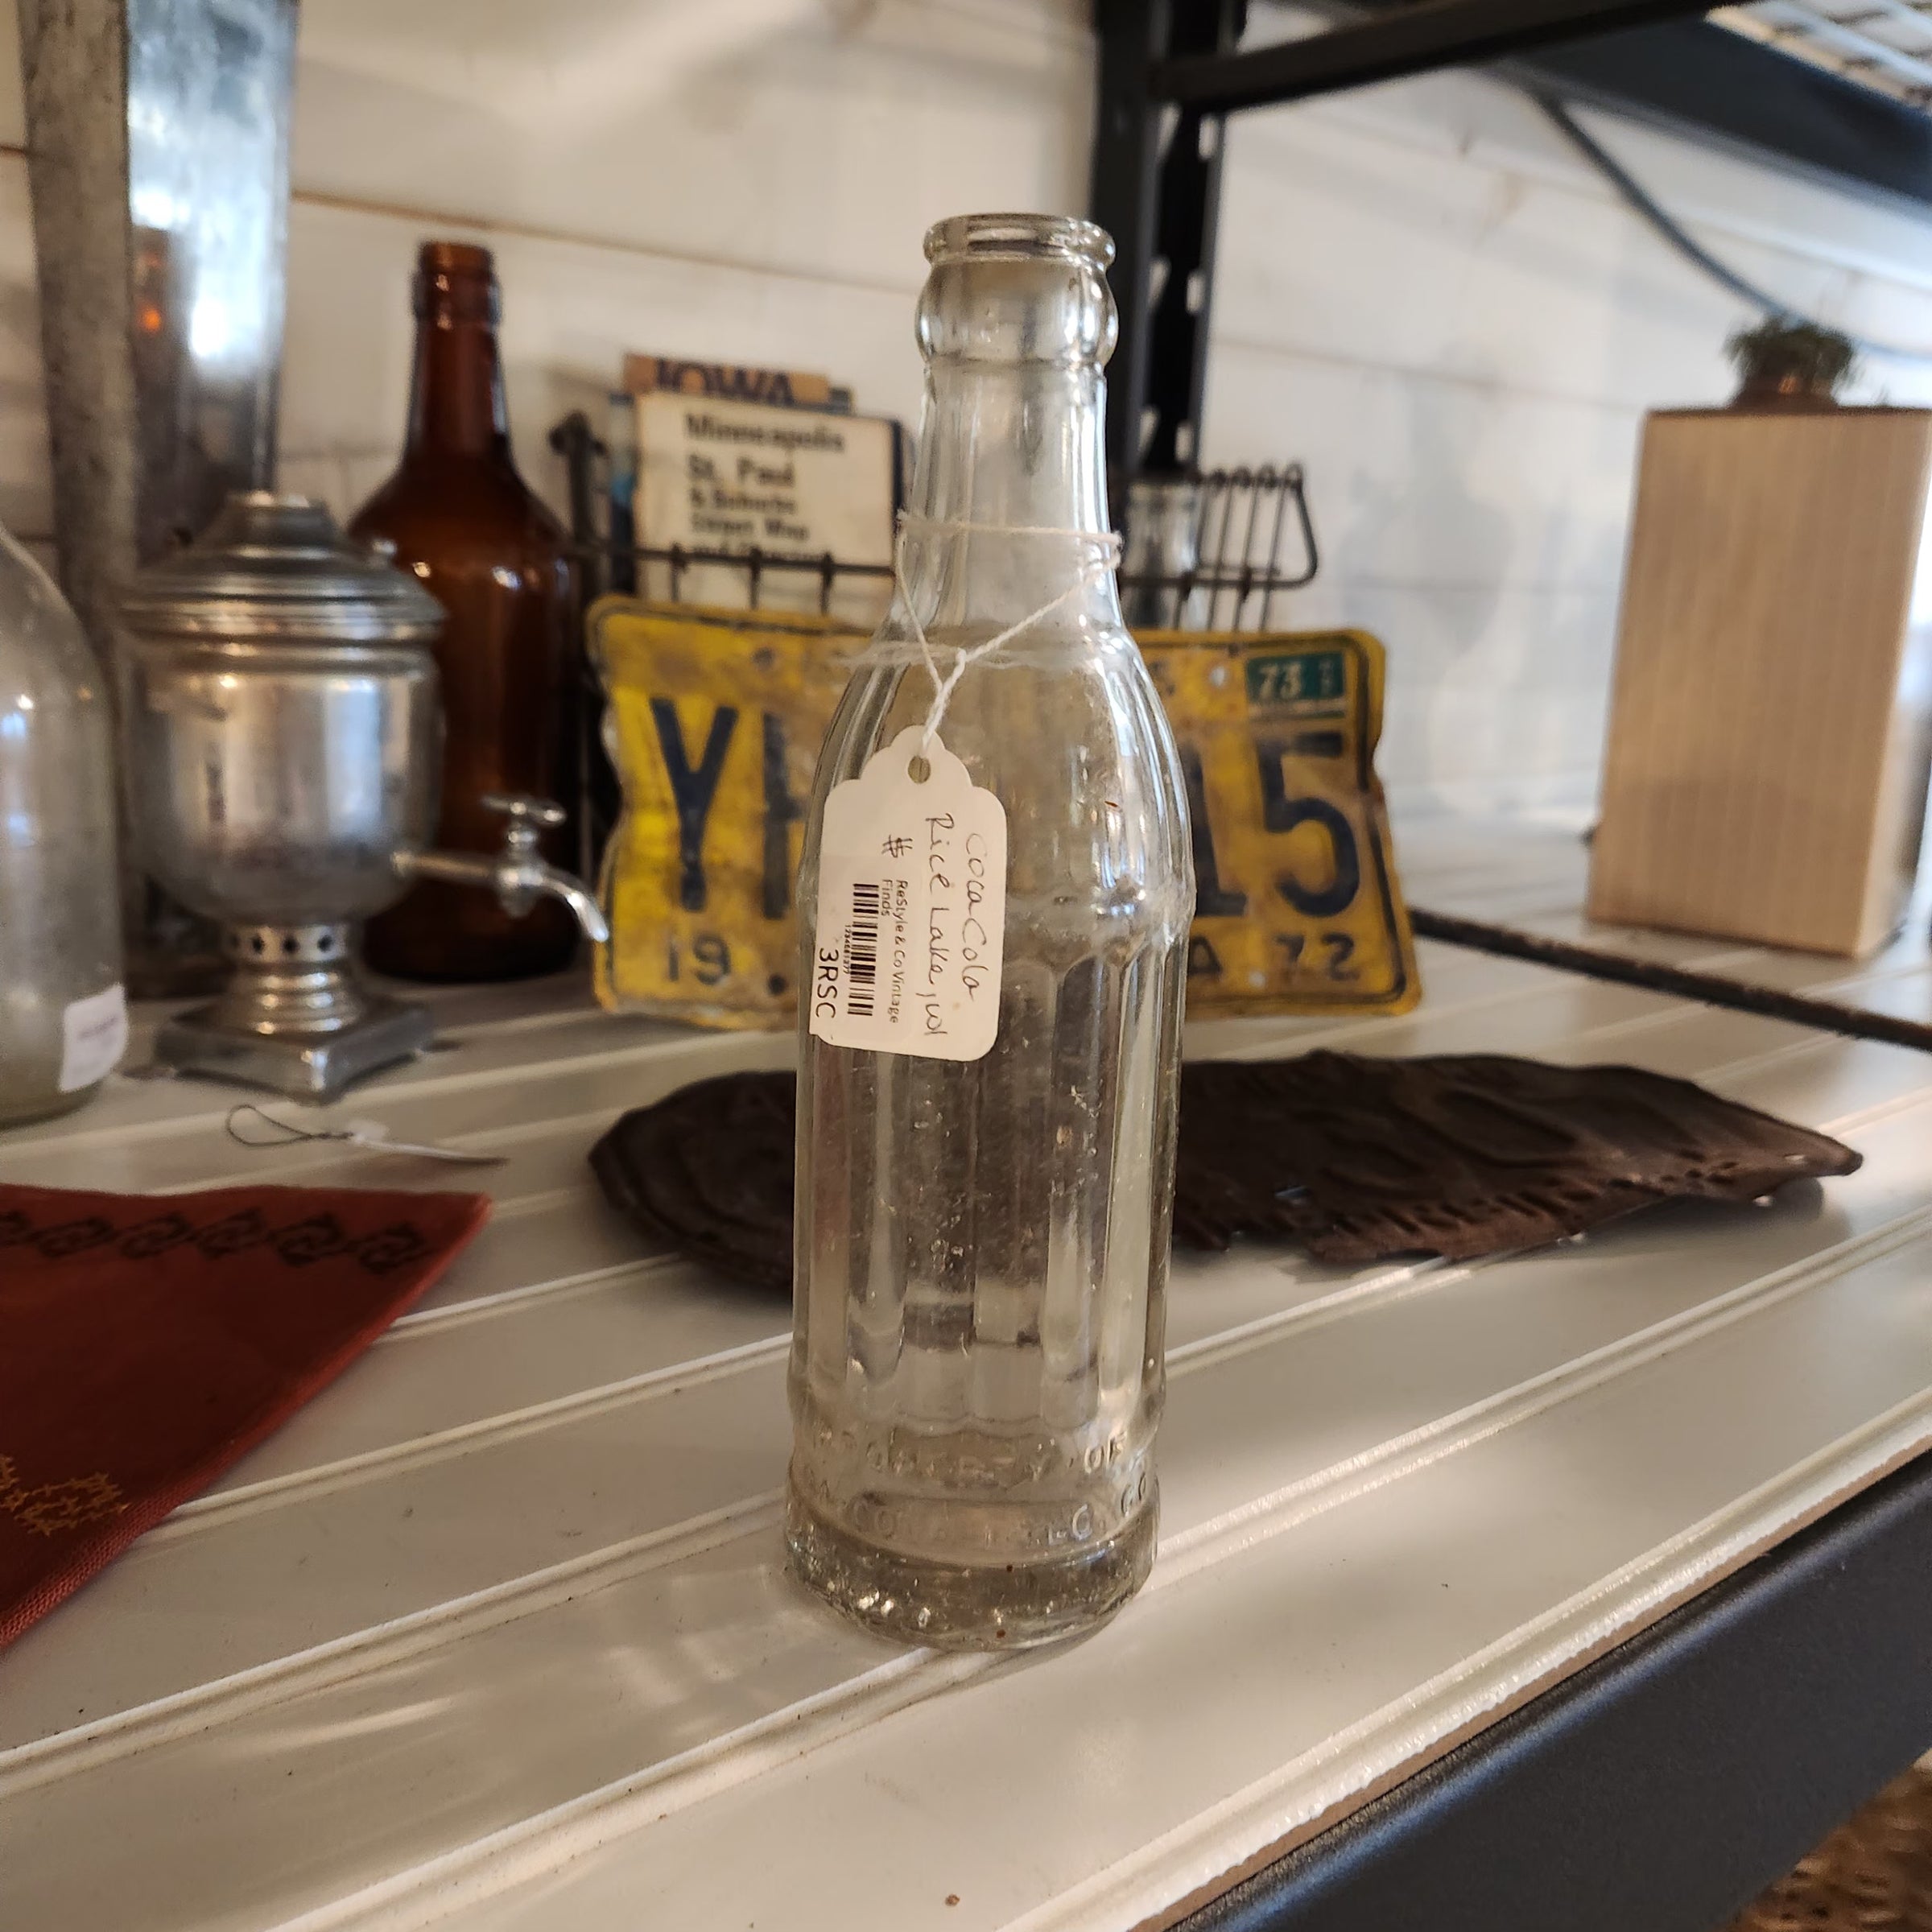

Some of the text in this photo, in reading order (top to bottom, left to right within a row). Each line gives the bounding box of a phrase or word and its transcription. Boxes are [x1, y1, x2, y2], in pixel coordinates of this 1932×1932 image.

[655, 357, 795, 405] IOWA
[925, 813, 955, 894] Rice
[881, 879, 893, 916] Finds
[893, 879, 908, 932] ReStyle
[667, 935, 732, 985] 19
[815, 947, 839, 1018] 3RSC
[894, 950, 906, 968] Co
[888, 971, 905, 1023] Vintage
